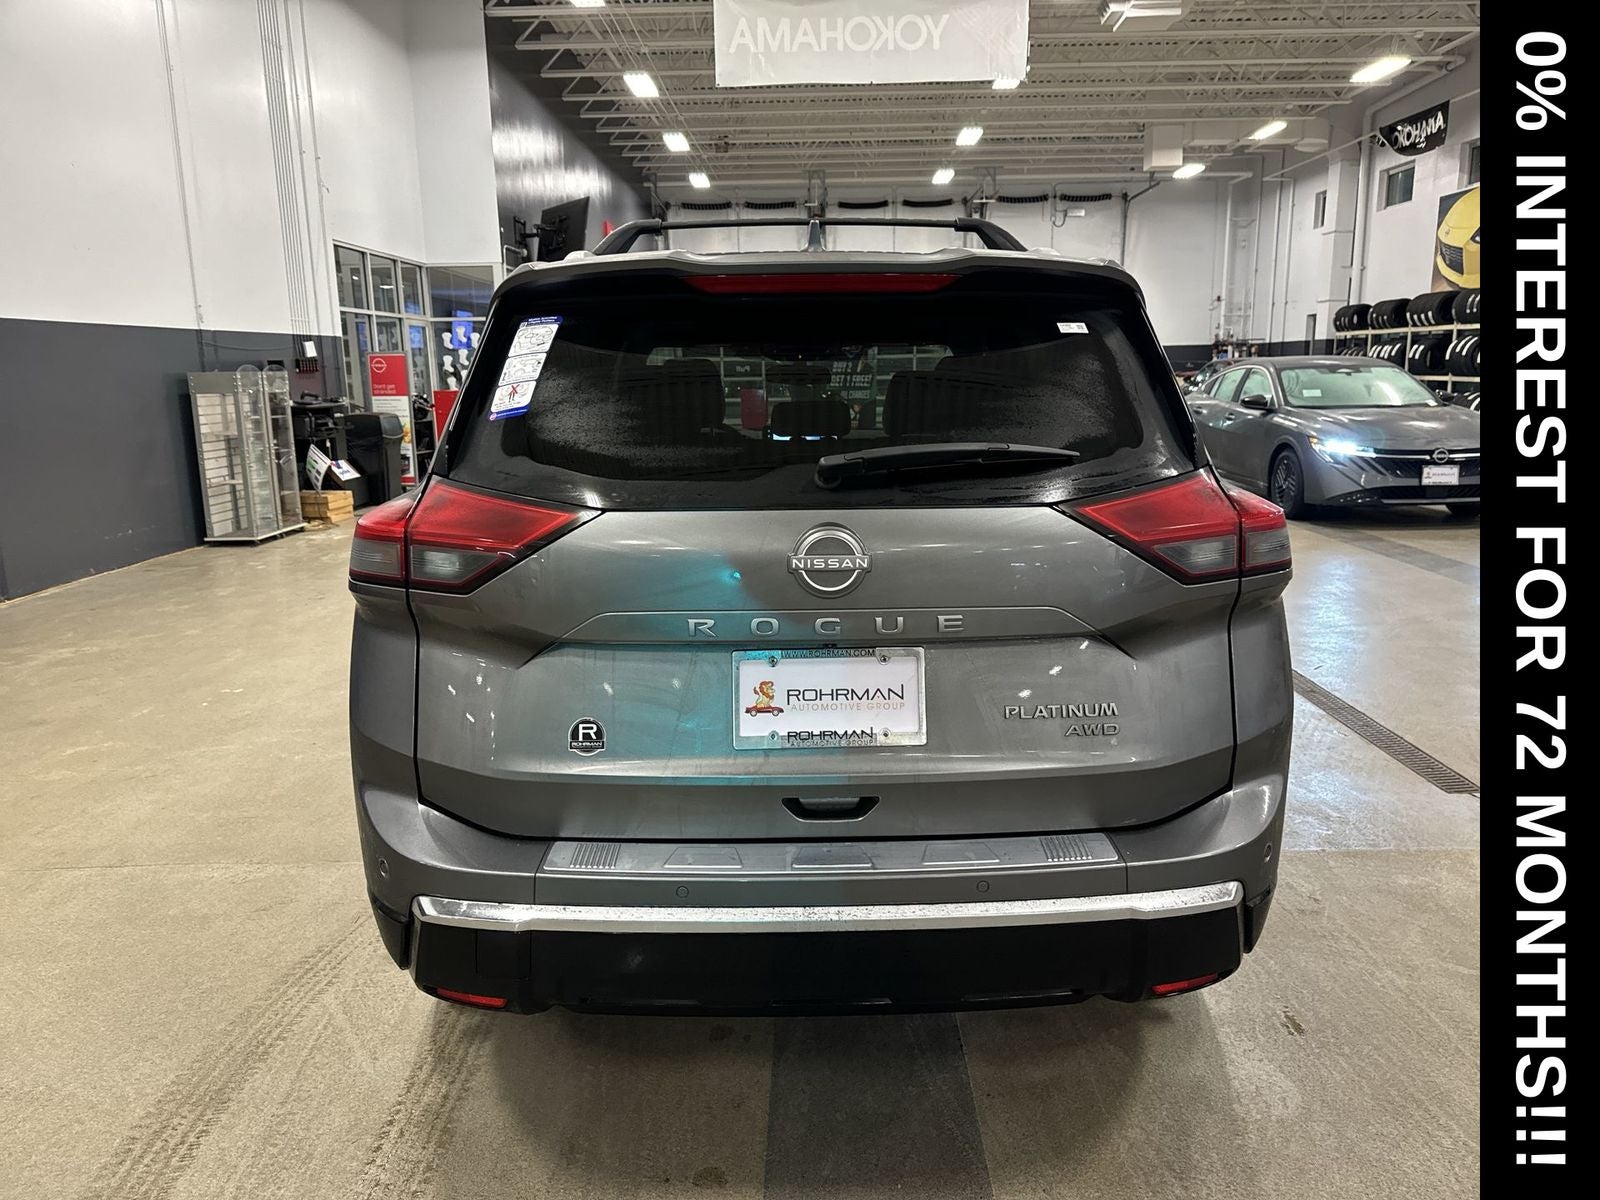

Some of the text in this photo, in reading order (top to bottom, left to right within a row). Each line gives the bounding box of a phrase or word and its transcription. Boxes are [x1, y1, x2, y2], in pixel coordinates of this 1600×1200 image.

[1391, 110, 1445, 150] OKOHAMA
[791, 557, 869, 569] NISSAN
[687, 614, 965, 638] ROGUE
[782, 649, 876, 658] WWW.ROHRMAN.COM
[786, 684, 905, 705] ROHRMAN
[791, 702, 905, 711] AUTOMOTIVE GROUP
[1004, 702, 1119, 720] PLATINUM
[578, 723, 598, 741] R
[787, 727, 874, 743] ROHRMAN
[1064, 723, 1120, 737] AWD
[790, 739, 846, 747] AUTOMOTIVE
